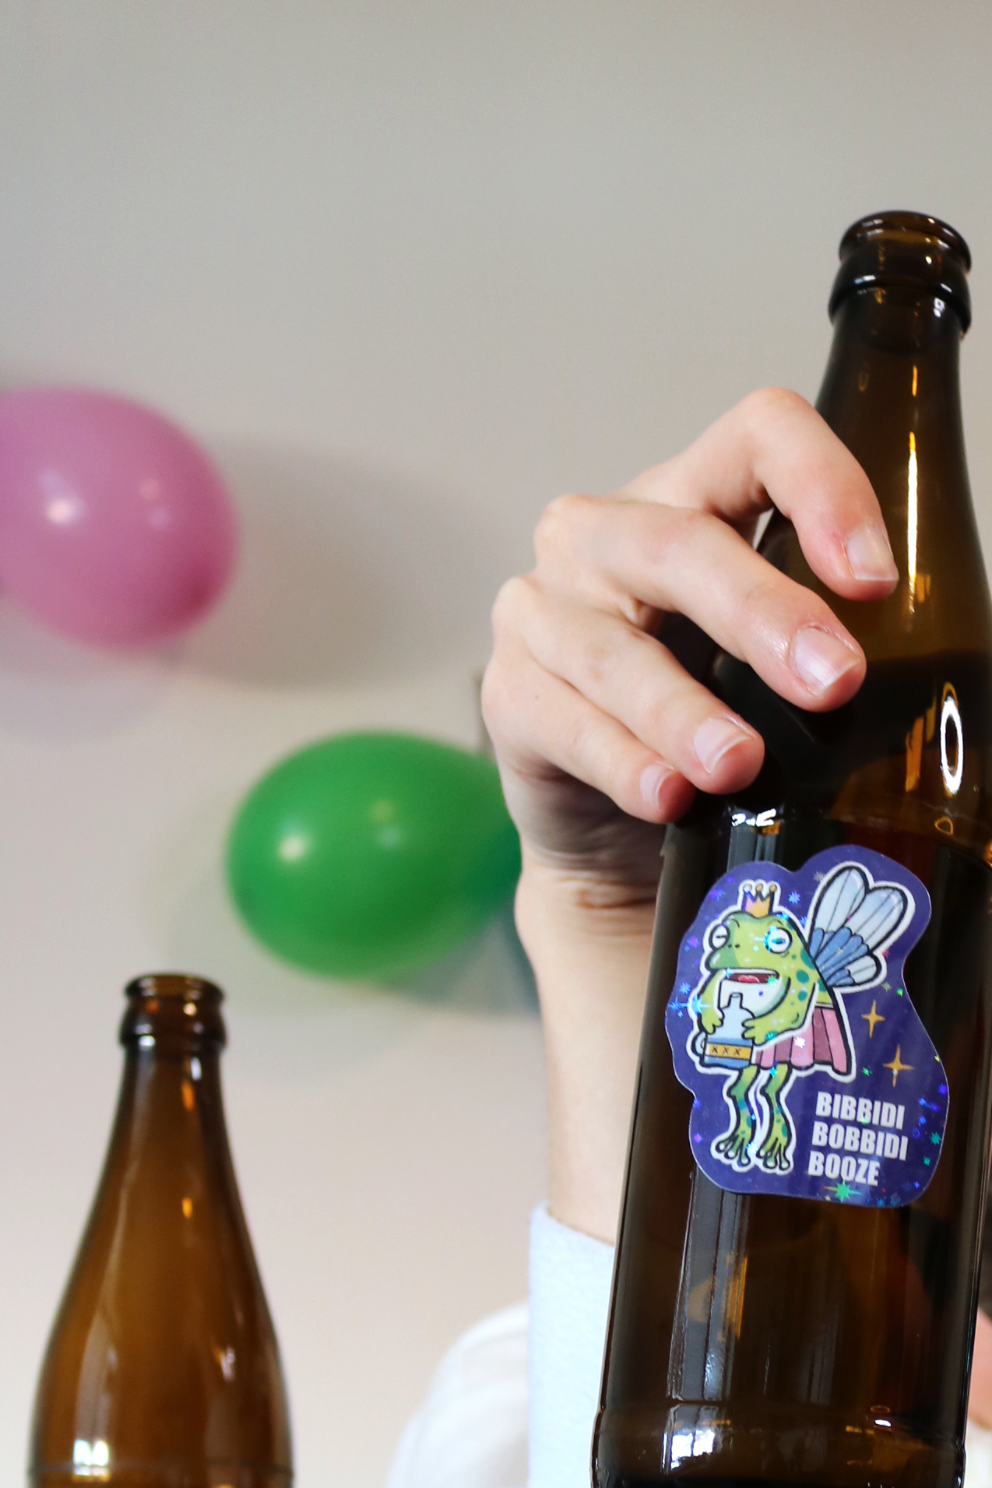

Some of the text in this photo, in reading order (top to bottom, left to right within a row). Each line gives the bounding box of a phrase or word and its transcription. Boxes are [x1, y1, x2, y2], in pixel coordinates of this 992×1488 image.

[815, 1091, 905, 1130] BIBBIDI
[811, 1120, 909, 1161] BOBBIDI
[807, 1150, 881, 1187] BOOZE
